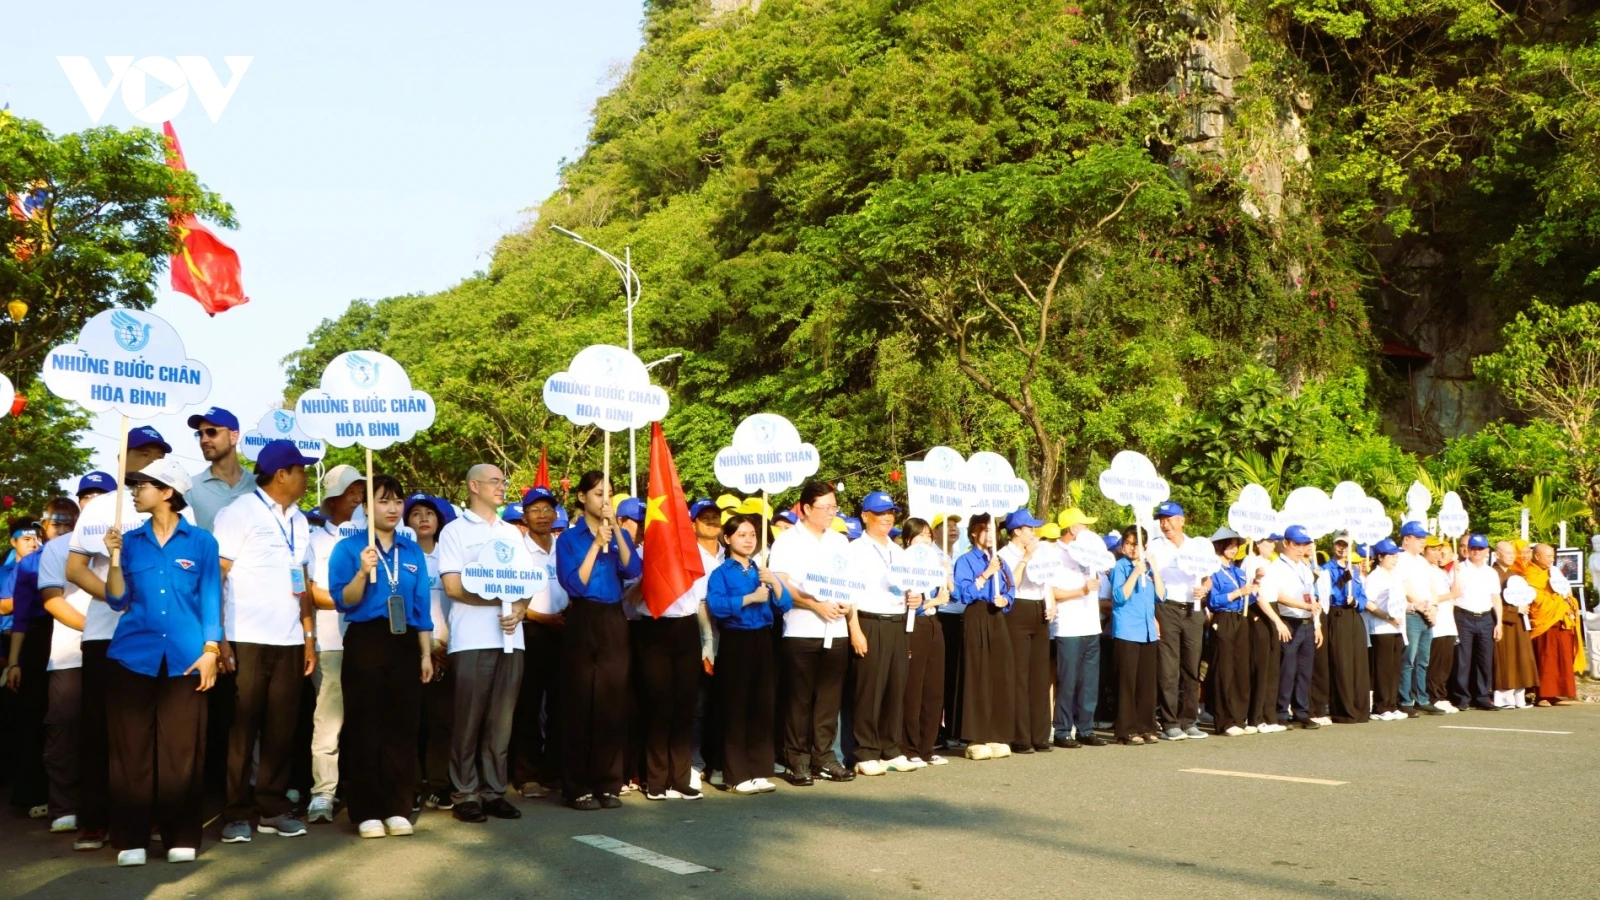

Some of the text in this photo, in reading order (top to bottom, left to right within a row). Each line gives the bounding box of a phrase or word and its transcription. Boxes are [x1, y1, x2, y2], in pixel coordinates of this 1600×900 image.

[52, 349, 201, 385] NHỮNG BƯỚC CHÂN
[91, 383, 166, 407] HÒA BÌNH
[301, 392, 349, 414] NHỮNG
[390, 396, 427, 412] CHÂN
[336, 420, 400, 437] HÒA BÌNH
[298, 439, 321, 451] CHÂN
